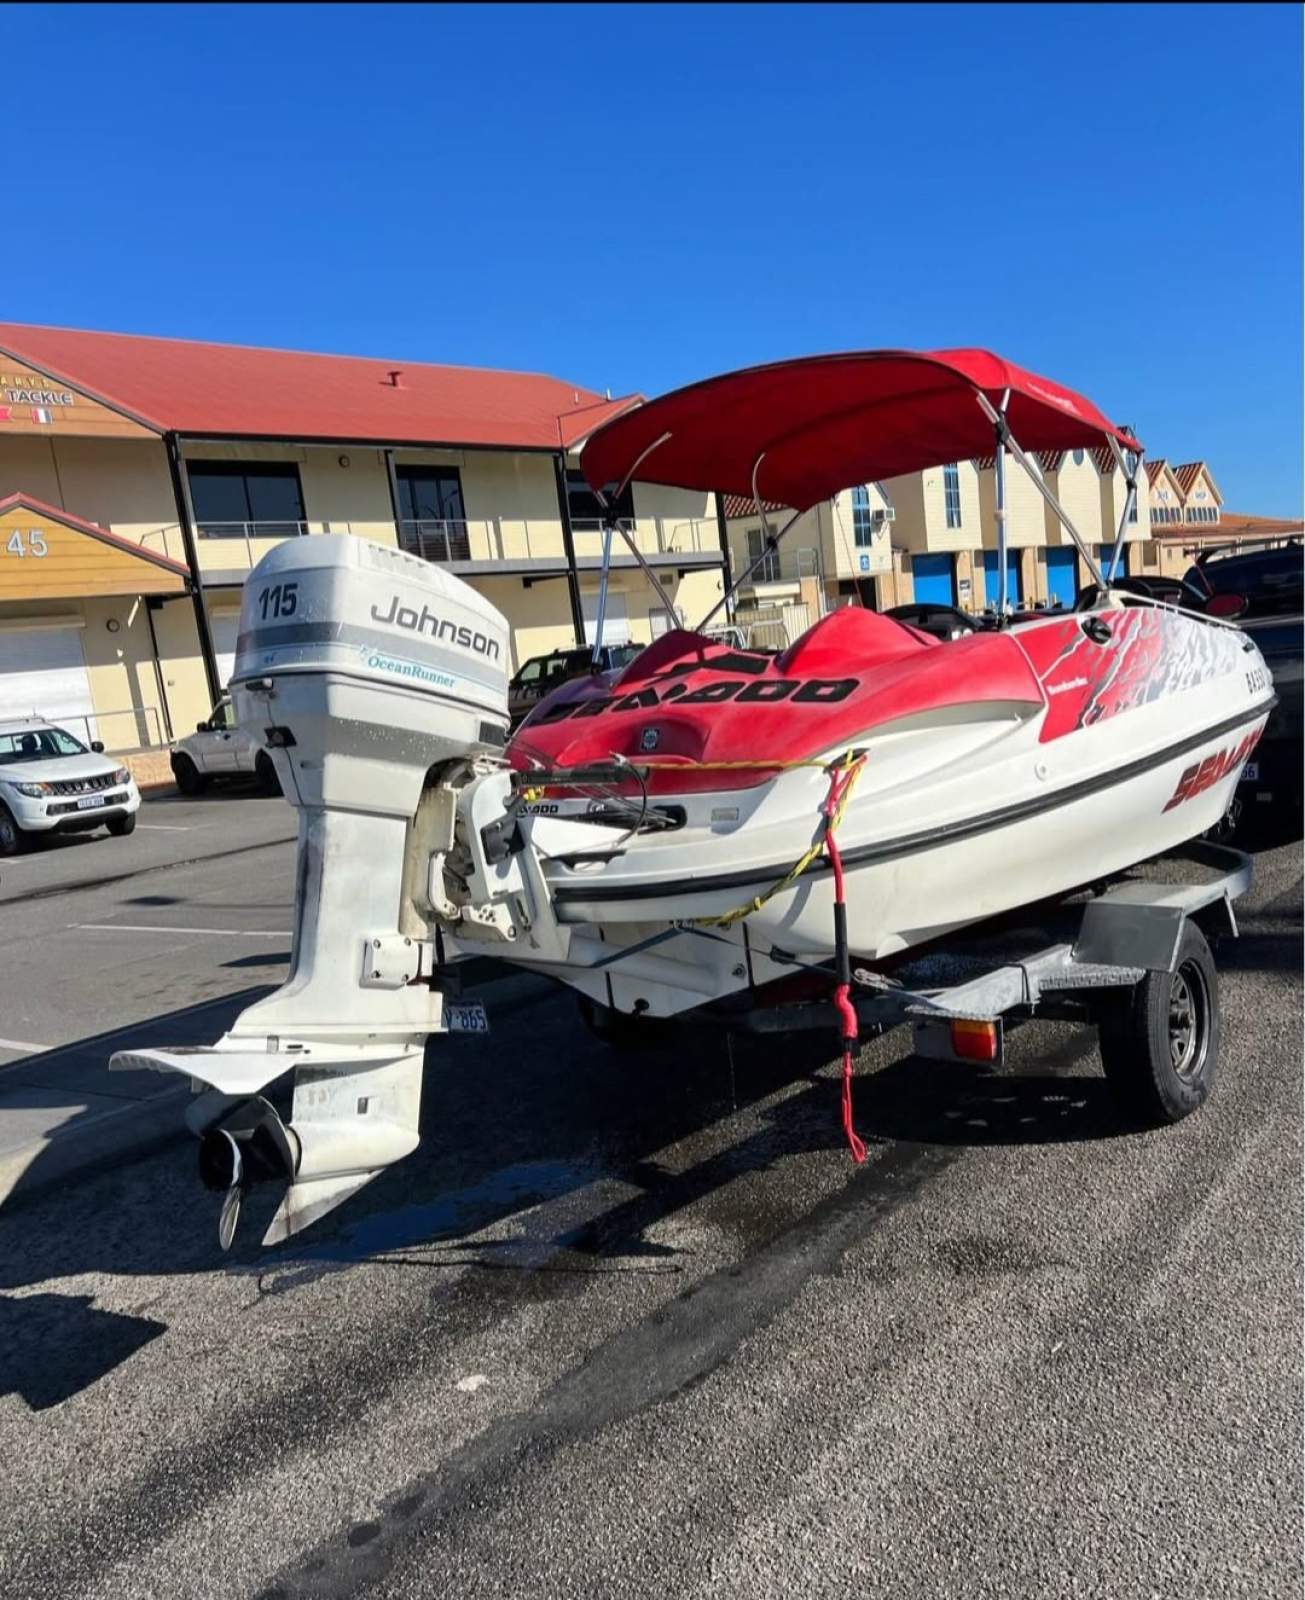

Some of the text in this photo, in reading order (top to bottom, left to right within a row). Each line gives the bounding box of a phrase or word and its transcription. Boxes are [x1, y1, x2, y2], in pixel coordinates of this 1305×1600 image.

[8, 389, 73, 405] TACKLE
[7, 530, 48, 558] 45
[258, 583, 298, 620] 115
[370, 596, 499, 660] Johnson
[367, 655, 455, 688] OceanRunner
